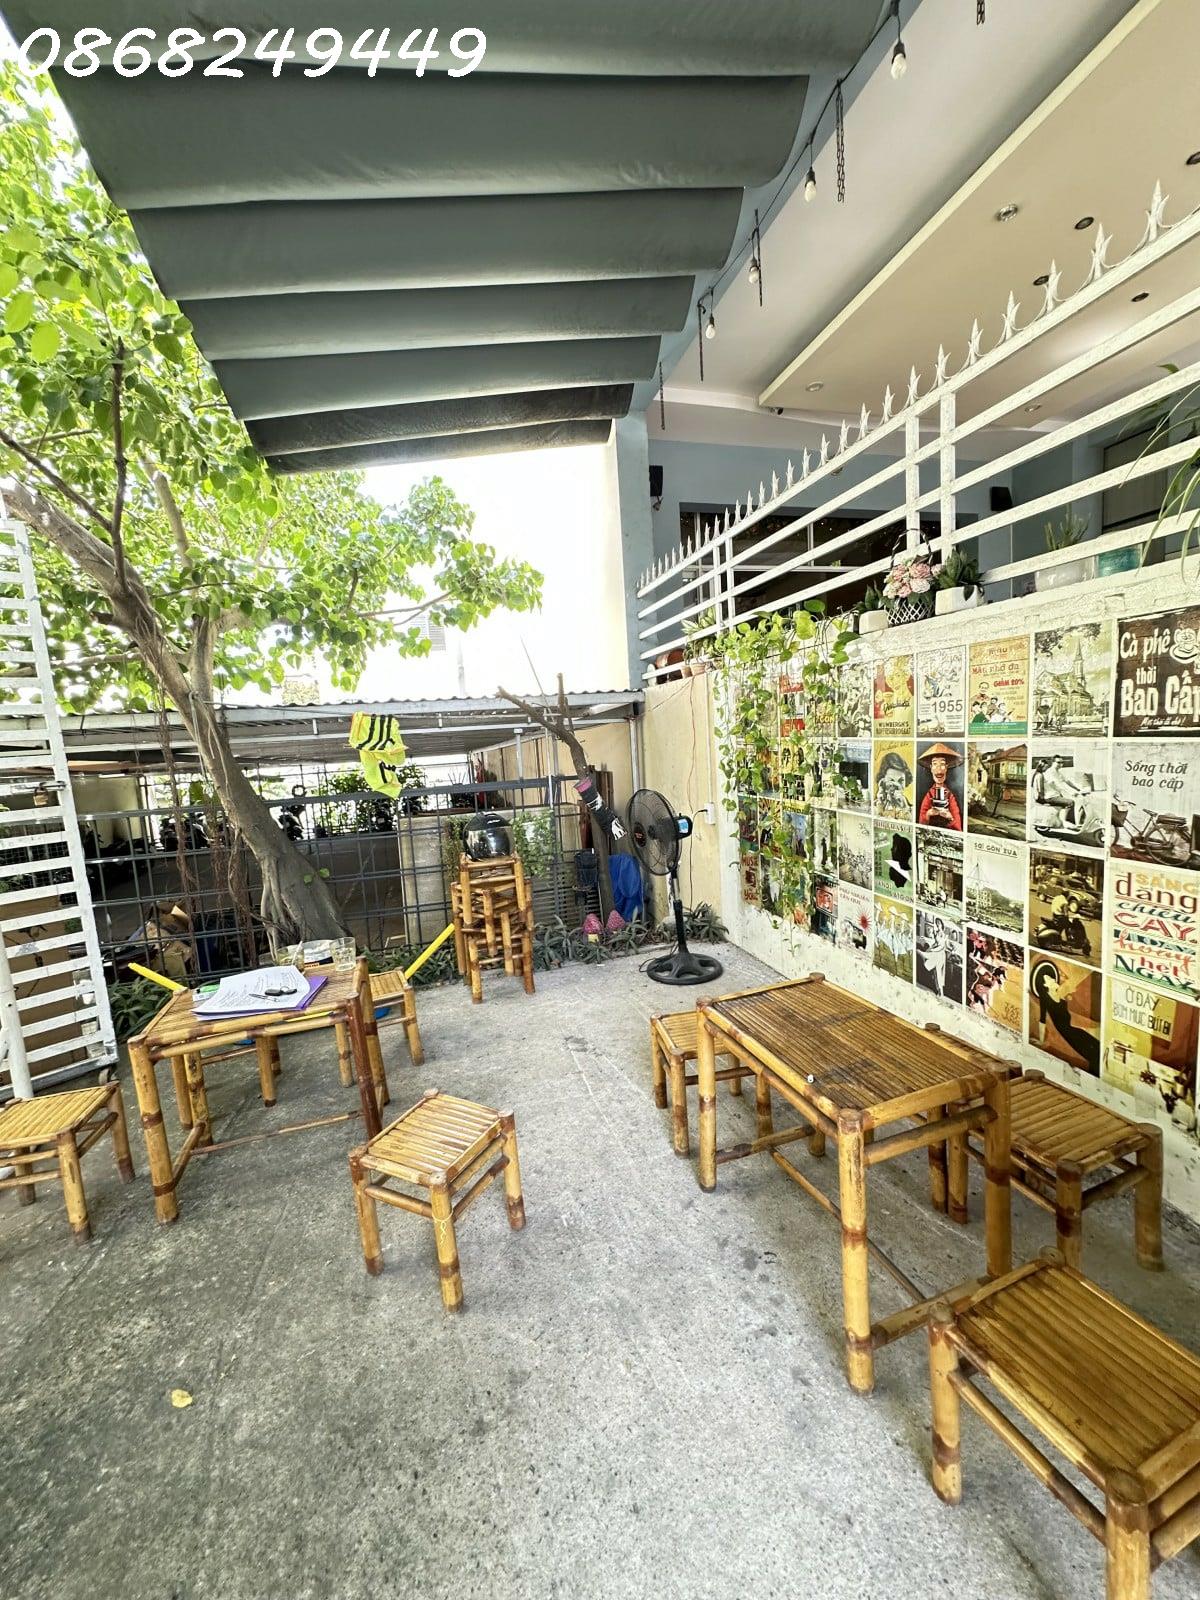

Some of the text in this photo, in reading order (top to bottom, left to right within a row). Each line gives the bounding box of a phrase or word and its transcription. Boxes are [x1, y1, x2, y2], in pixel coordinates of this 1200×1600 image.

[1120, 627, 1171, 663] Cà phê
[1135, 665, 1157, 684] thời
[932, 699, 964, 714] 1955
[1120, 679, 1159, 718] Bao
[1125, 759, 1188, 776] Sống thời
[1132, 776, 1184, 792] bao cấp
